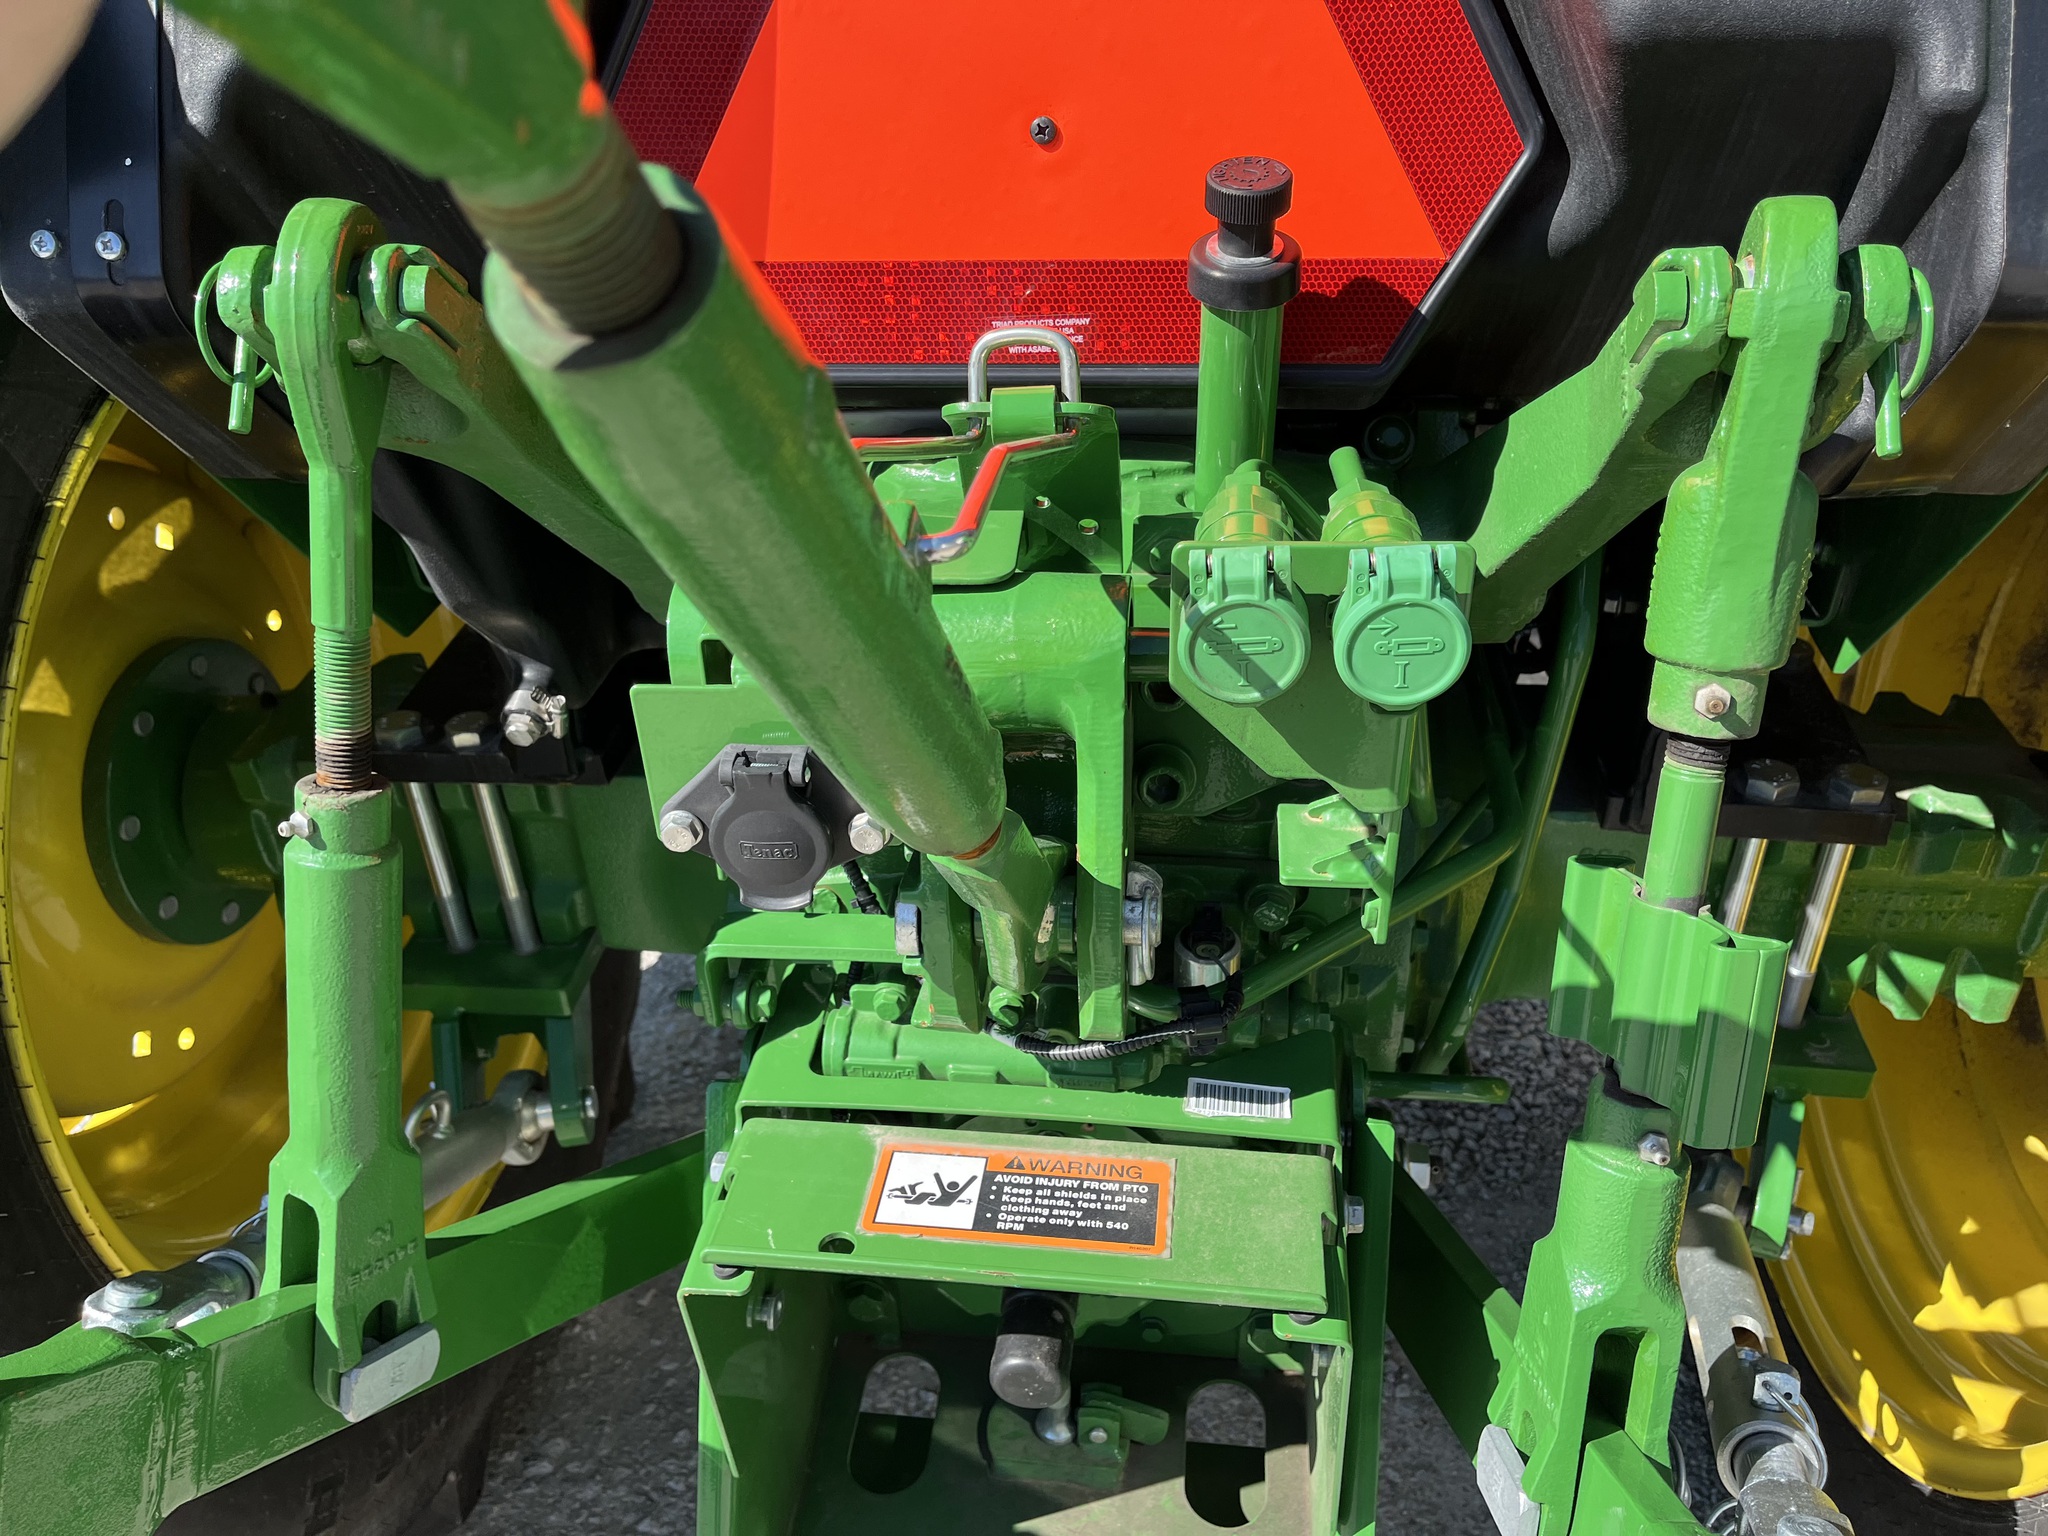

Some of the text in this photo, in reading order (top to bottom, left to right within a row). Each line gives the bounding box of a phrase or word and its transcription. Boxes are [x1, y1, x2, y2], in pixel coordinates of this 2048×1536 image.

[992, 320, 1013, 328] TRIAD
[1055, 318, 1091, 326] COMPANY
[1009, 346, 1027, 354] WITH
[1029, 1157, 1143, 1180] WARNING
[994, 1174, 1149, 1194] AVOID INJURY FROM PTO
[1001, 1194, 1127, 1212] Keep hands, feet and
[1003, 1185, 1148, 1205] Keep all shields in place
[1000, 1204, 1083, 1218] clothing away
[996, 1222, 1025, 1232] RPM
[997, 1213, 1129, 1231] Operate only with 540
